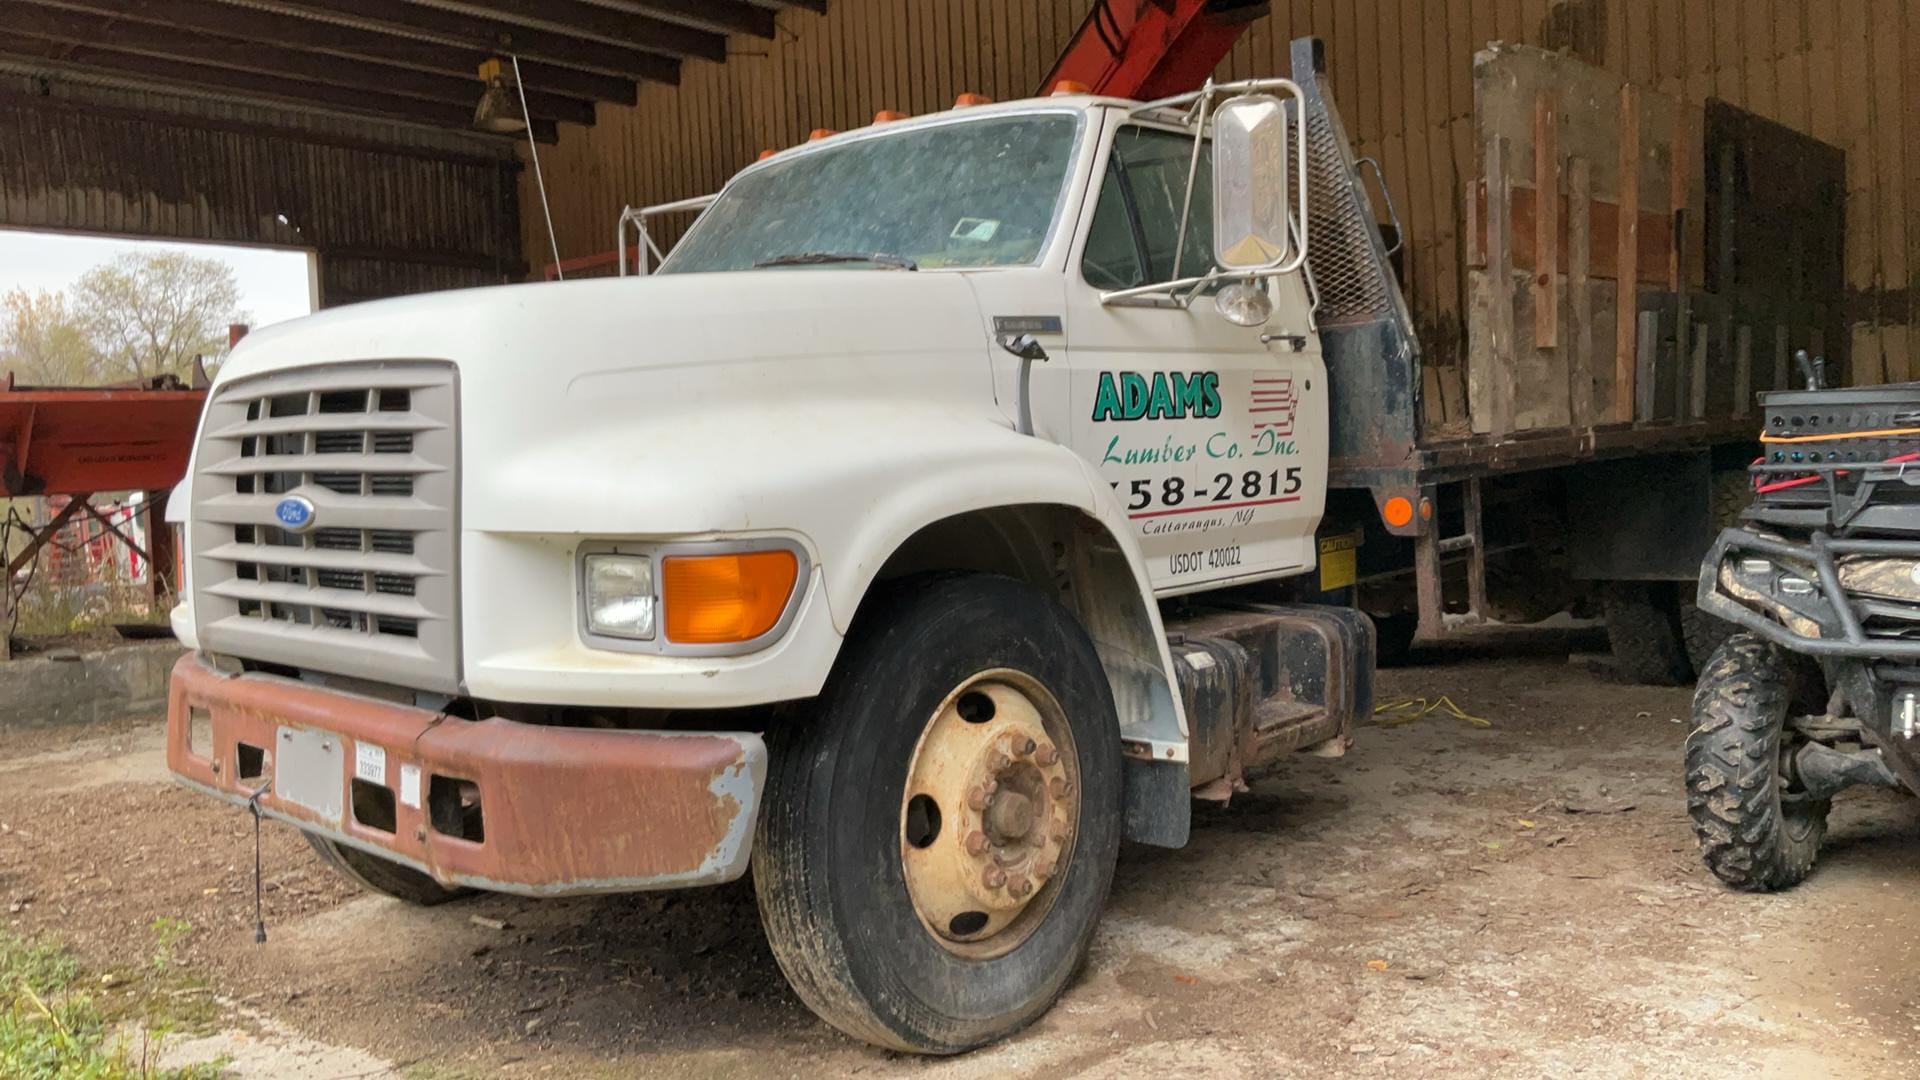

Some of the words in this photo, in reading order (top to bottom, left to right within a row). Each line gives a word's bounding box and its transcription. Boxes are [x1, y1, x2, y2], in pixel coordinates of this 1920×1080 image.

[1092, 371, 1222, 421] ADAMS
[1101, 435, 1196, 467] Lumber
[1206, 432, 1243, 458] Co.
[1252, 429, 1300, 455] Inc.
[1110, 467, 1302, 510] 58-2815
[281, 504, 303, 521] Ford
[1142, 517, 1226, 535] Cattaraugus,
[1231, 509, 1255, 528] NY
[1169, 552, 1203, 574] USDOT
[1208, 545, 1241, 567] 420022
